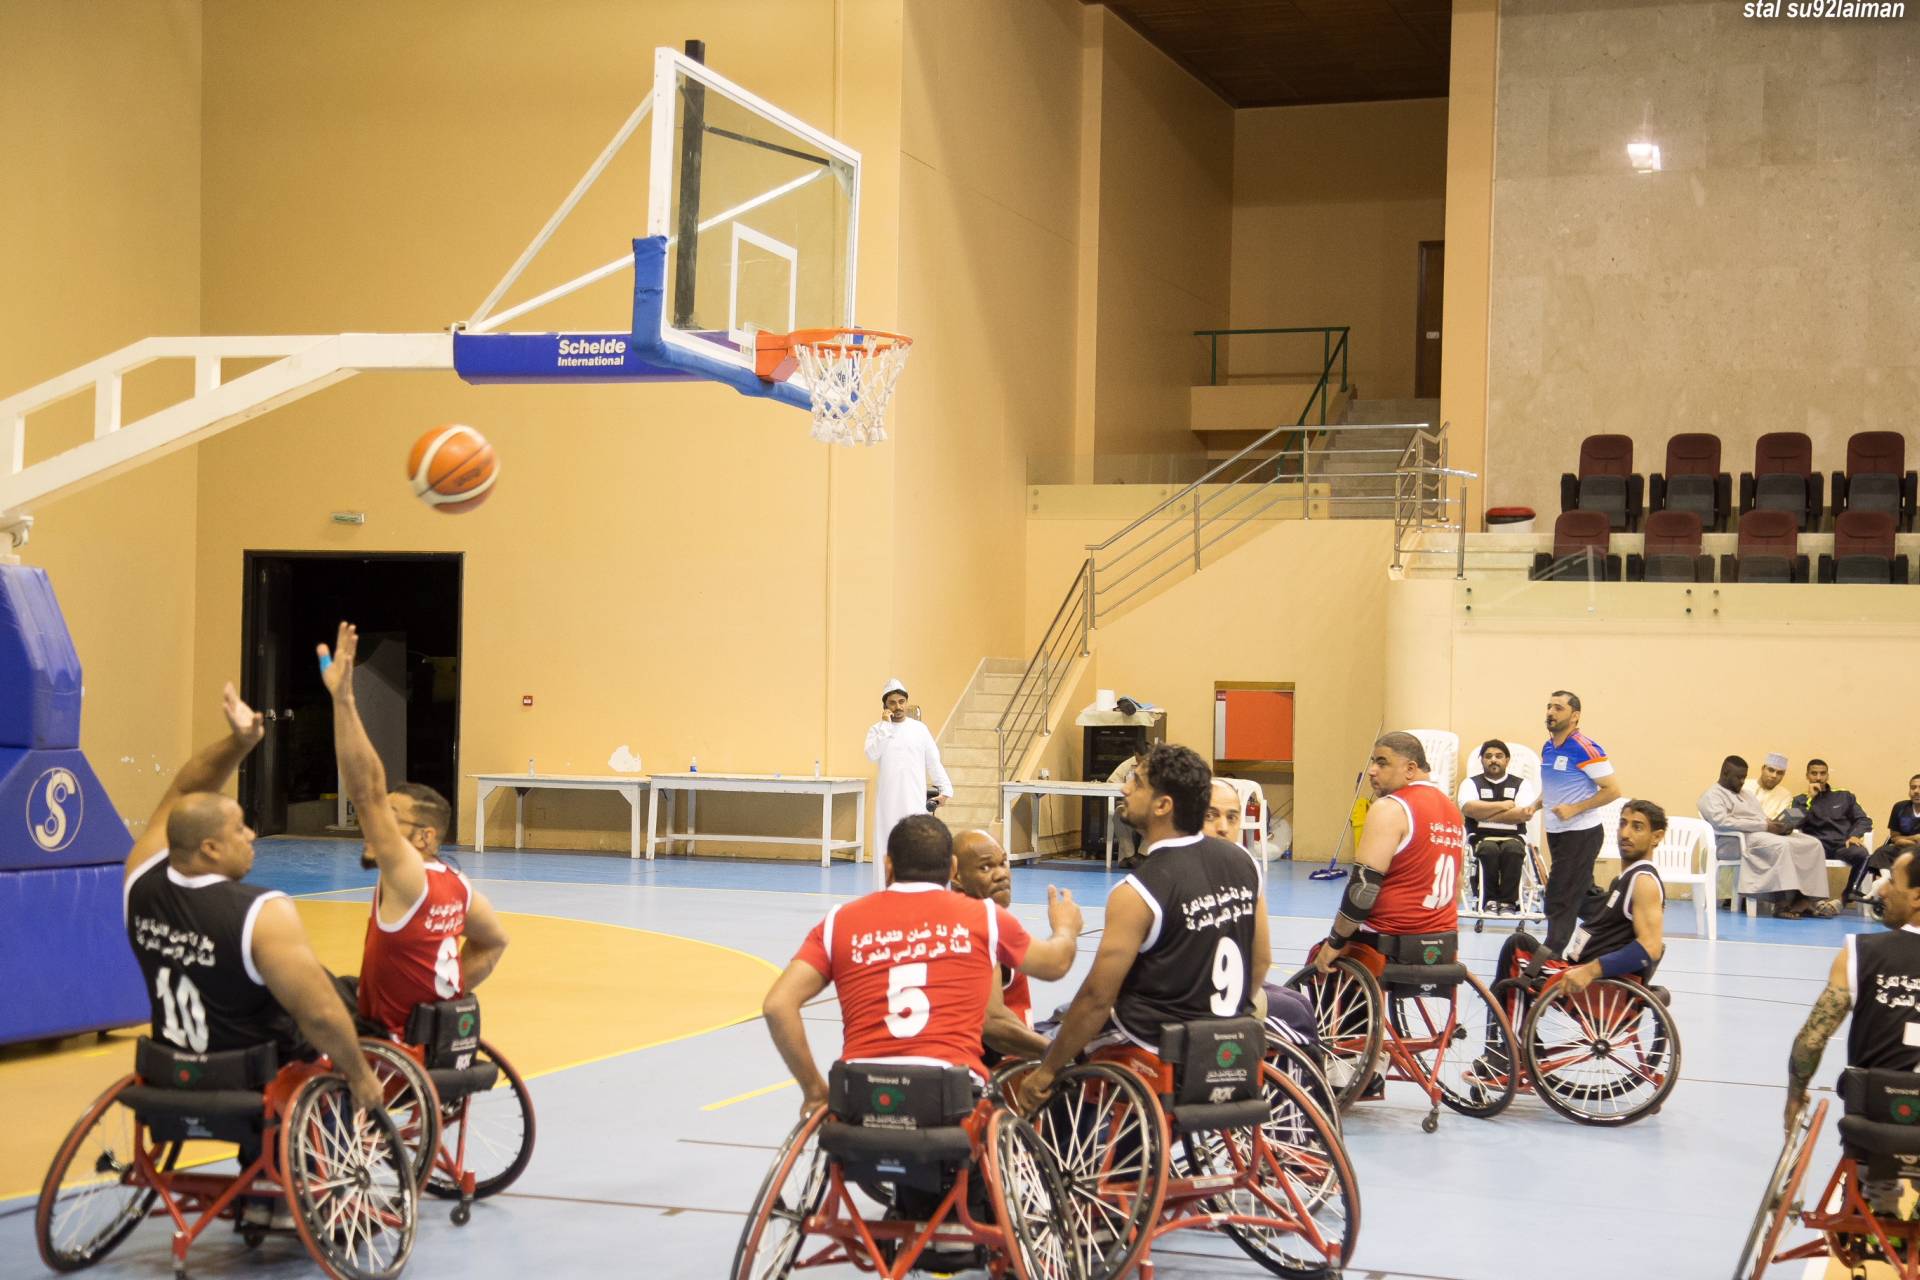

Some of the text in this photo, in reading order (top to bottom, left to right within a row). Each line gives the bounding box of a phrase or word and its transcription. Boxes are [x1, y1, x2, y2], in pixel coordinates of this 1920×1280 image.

[558, 355, 624, 367] International
[559, 339, 626, 355] Schelde
[1422, 853, 1455, 910] 10
[434, 936, 460, 999] 6
[1209, 936, 1244, 1017] 9
[156, 967, 209, 1054] 10
[883, 962, 930, 1039] 5
